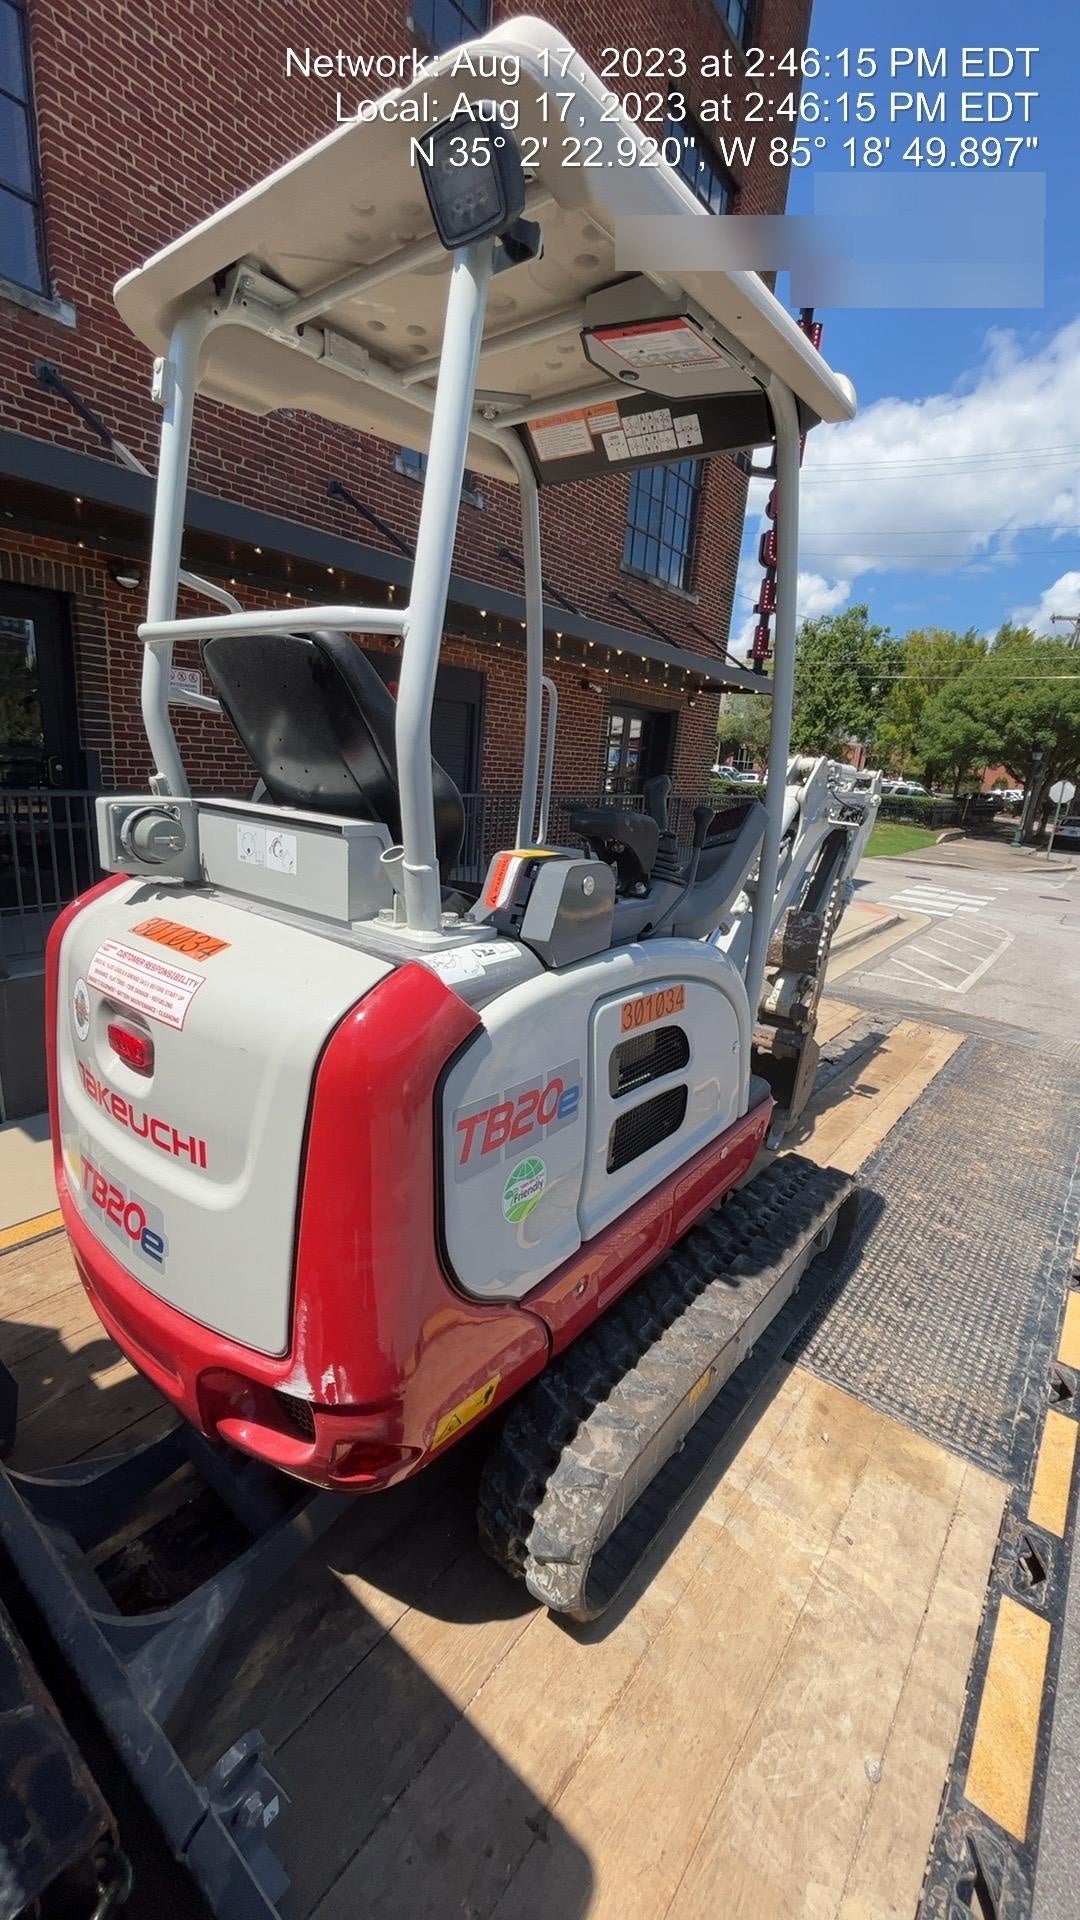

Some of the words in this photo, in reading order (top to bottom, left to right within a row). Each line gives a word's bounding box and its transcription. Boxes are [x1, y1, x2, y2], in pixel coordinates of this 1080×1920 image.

[130, 917, 228, 960] 301034
[116, 948, 145, 966] CUSTOMER
[143, 960, 198, 989] RESPONSIBILITY
[149, 982, 164, 993] BEFORE
[164, 989, 178, 999] START
[623, 985, 684, 1030] 301034
[158, 1009, 180, 1023] CLEANING
[456, 1077, 579, 1165] TB20e
[80, 1154, 164, 1264] TB20e
[514, 1180, 543, 1204] Friendly
